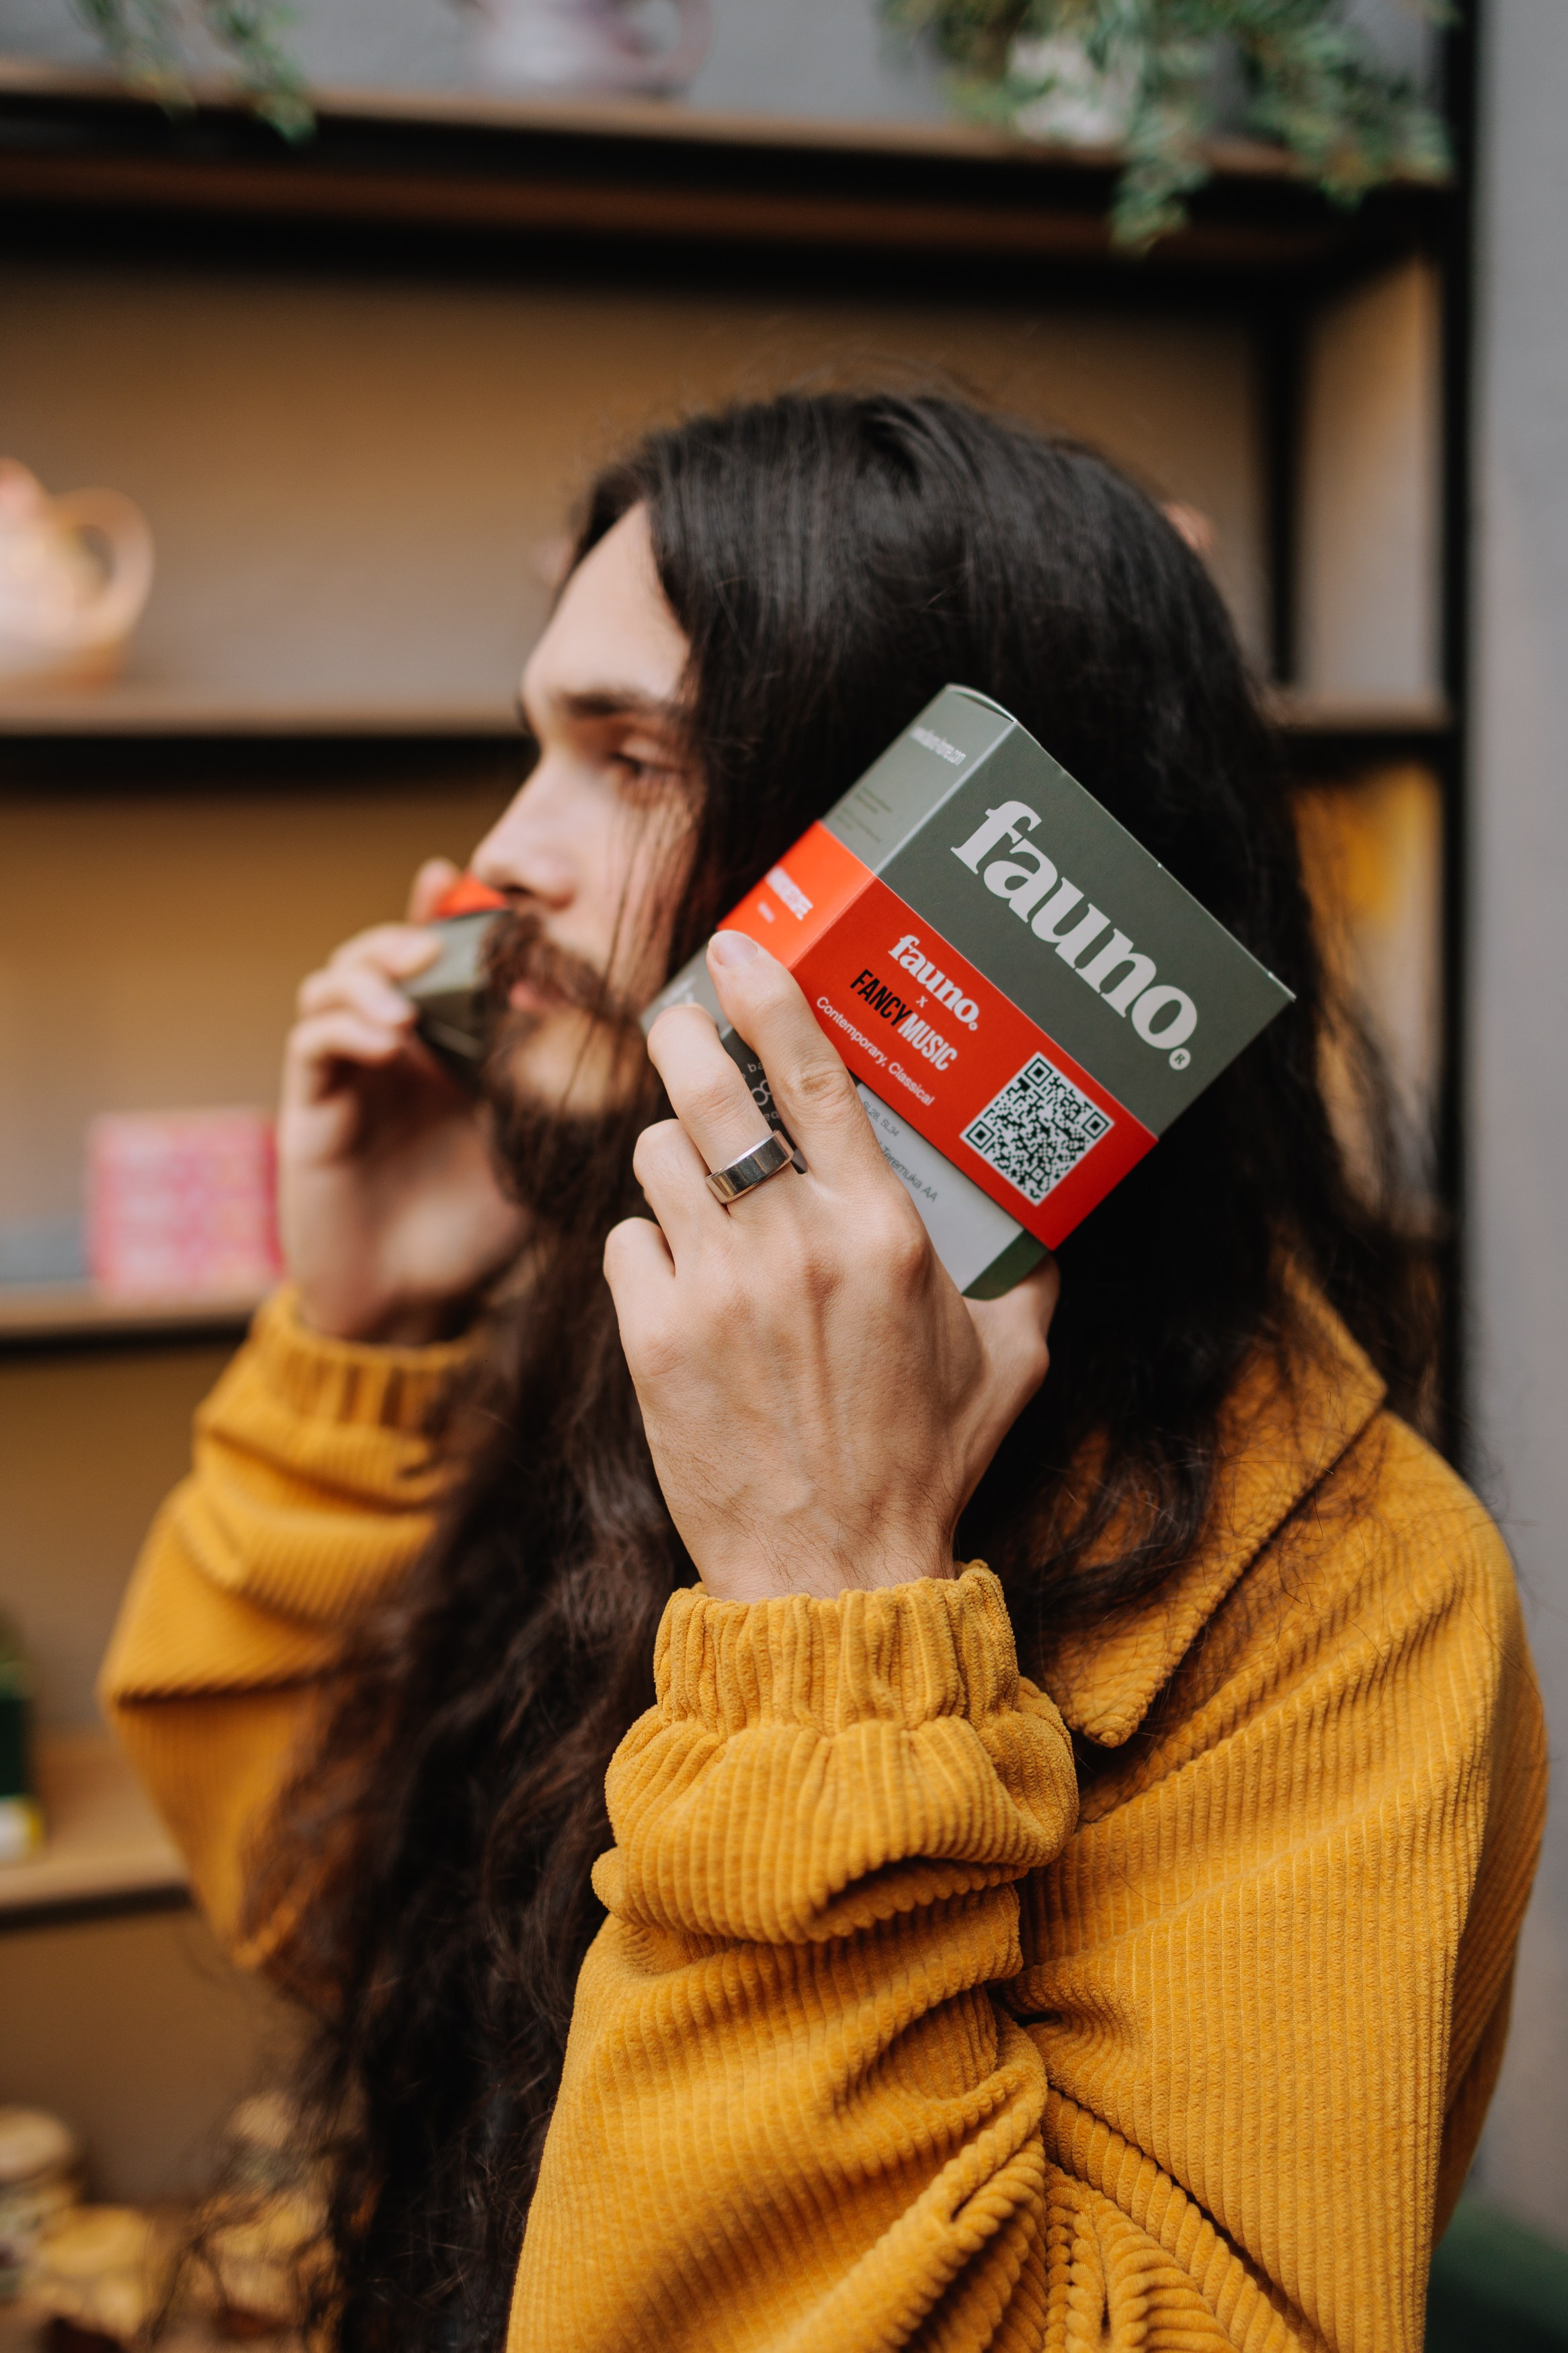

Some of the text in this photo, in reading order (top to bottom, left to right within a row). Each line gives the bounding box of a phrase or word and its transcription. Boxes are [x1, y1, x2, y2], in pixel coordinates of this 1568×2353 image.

[817, 996, 935, 1107] Contemporary, Classical
[880, 1119, 899, 1137] SL34
[921, 1187, 938, 1203] AA
